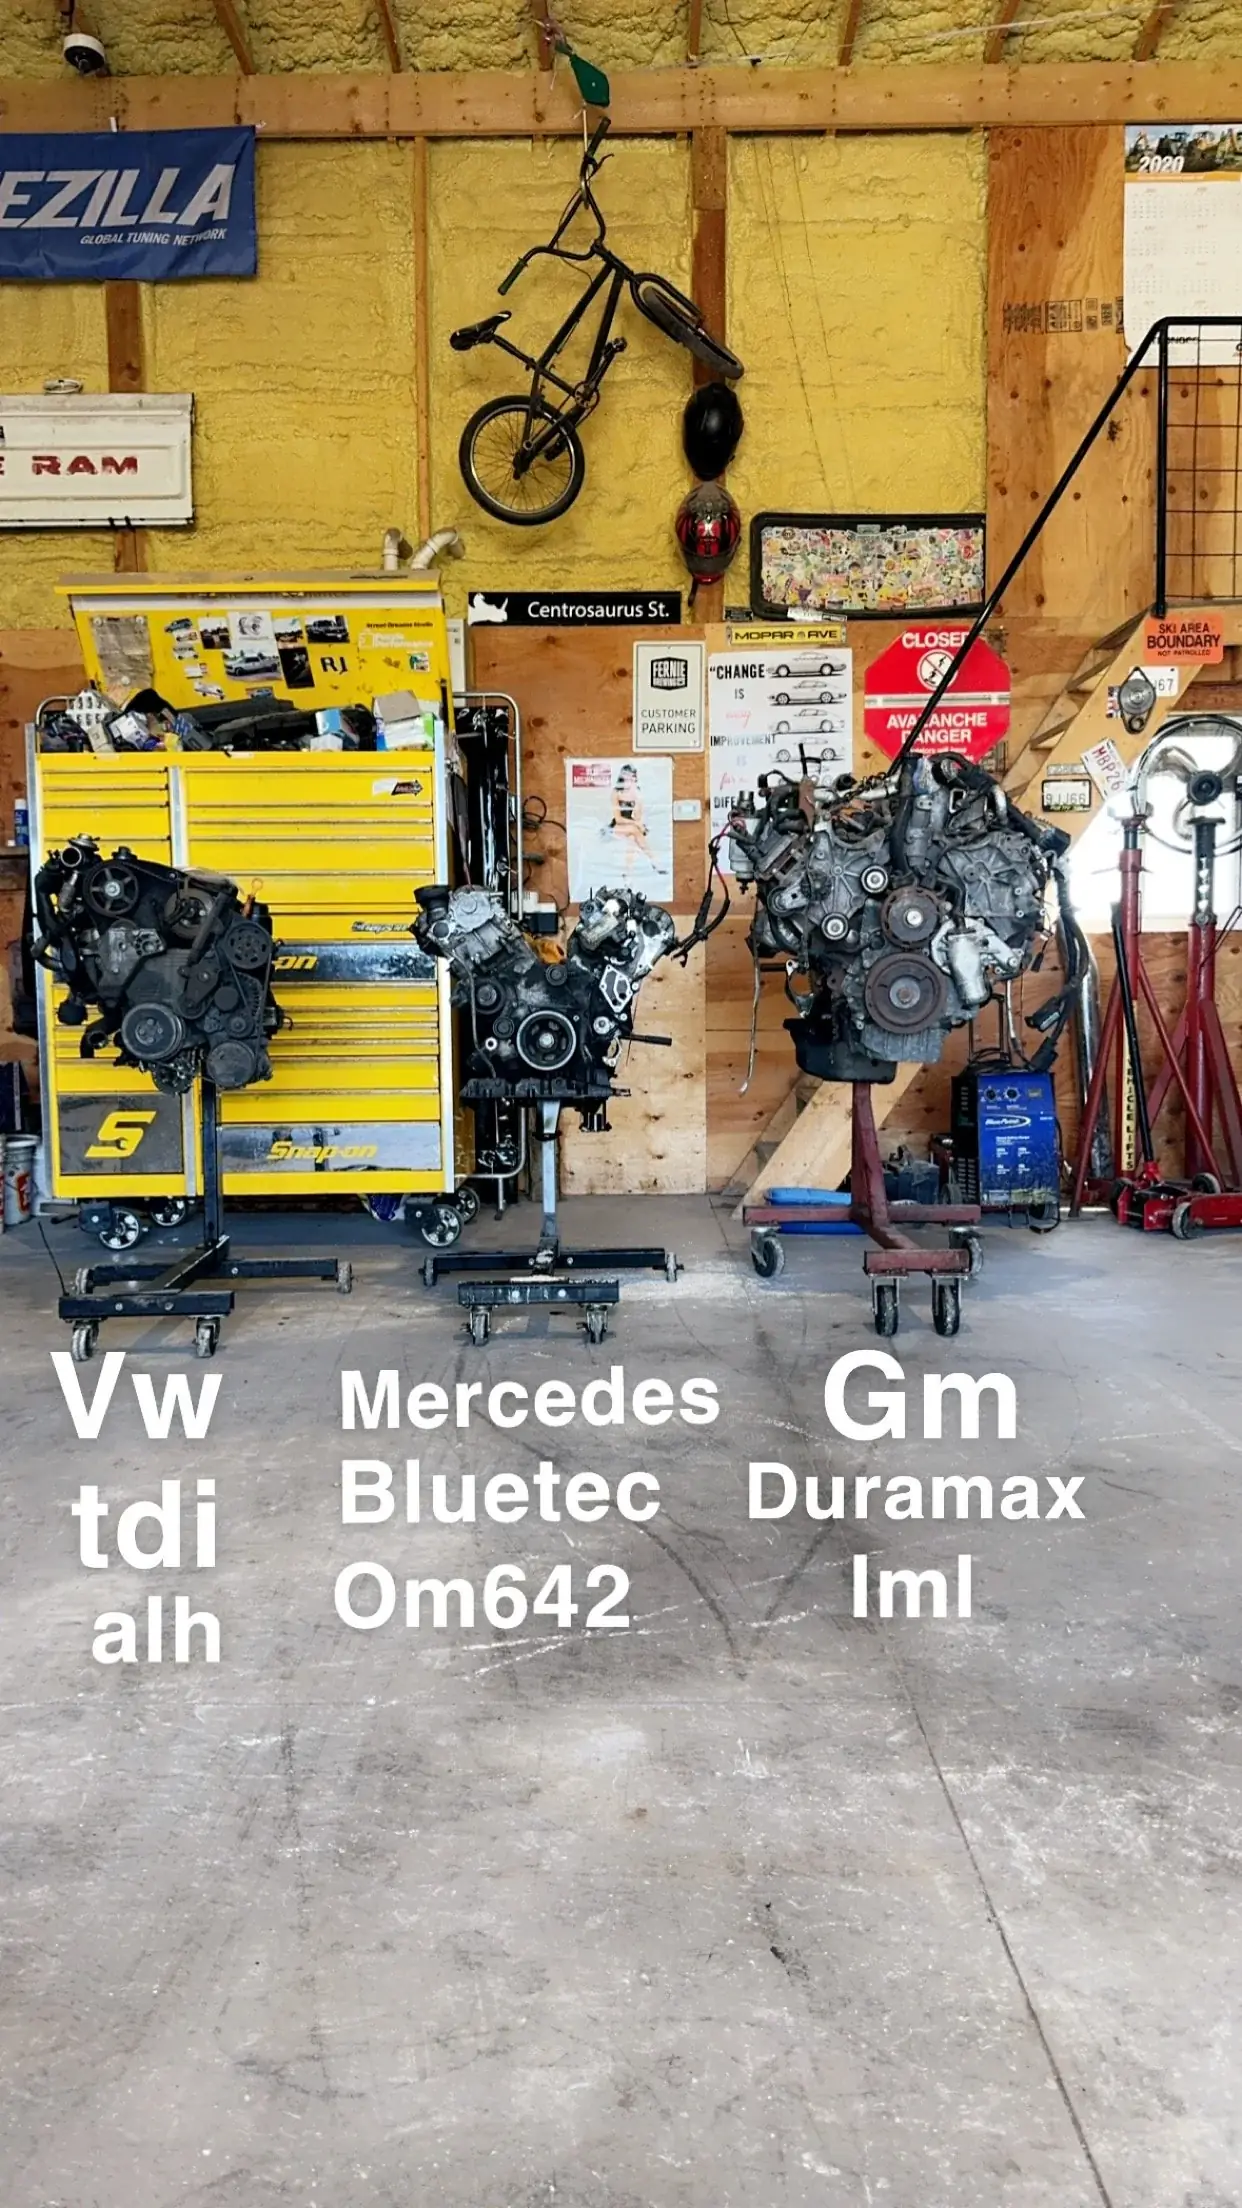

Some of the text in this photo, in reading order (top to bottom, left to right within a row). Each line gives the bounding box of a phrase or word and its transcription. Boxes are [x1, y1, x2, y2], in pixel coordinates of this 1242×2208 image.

[1138, 155, 1185, 173] 2020
[0, 164, 236, 228] EZILLA
[80, 228, 227, 246] GLOBAL TUNING NETWORK
[31, 455, 138, 475] RAM
[527, 601, 669, 618] Centrosaurus St.
[735, 630, 837, 640] MOPAR AVE
[1158, 622, 1209, 634] SKI AREA
[1147, 634, 1220, 649] BOUNDARY
[652, 660, 686, 678] FERNIE
[735, 688, 745, 699] IS
[641, 709, 696, 718] CUSTOMER
[886, 712, 988, 729] AVAANCHE
[642, 722, 696, 734] PARKING
[710, 733, 776, 747] IMPROVEMENT
[1126, 1057, 1134, 1121] EHICLE
[266, 1141, 378, 1164] Snap-on
[1126, 1125, 1134, 1169] LIFTS
